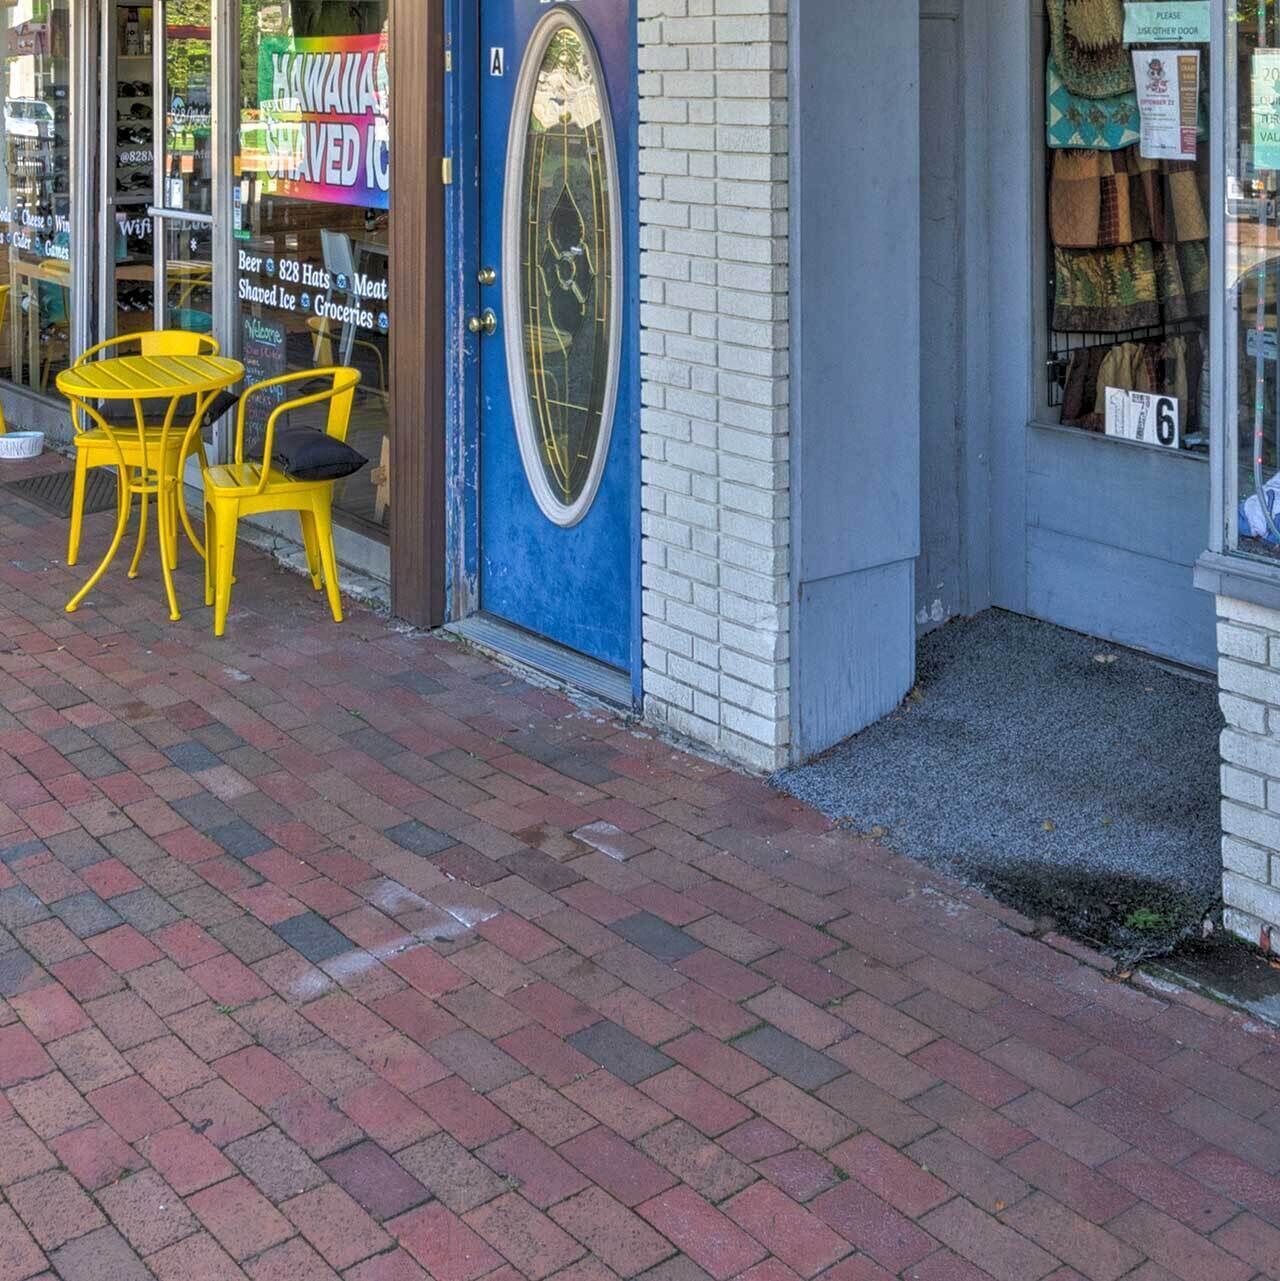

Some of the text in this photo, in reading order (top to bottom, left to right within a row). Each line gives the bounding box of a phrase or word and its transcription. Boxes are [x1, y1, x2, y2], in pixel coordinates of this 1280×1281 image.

[1156, 12, 1181, 20] PLEASE
[1137, 26, 1199, 35] USE OTHER DOOR
[491, 48, 502, 75] A
[1263, 67, 1280, 81] 20
[265, 122, 361, 186] SHAVED
[22, 209, 45, 228] Cheese
[119, 219, 152, 238] Wifi
[13, 231, 31, 250] Cider
[45, 240, 69, 260] Games
[238, 249, 388, 301] Beer 828 Hats Meat
[238, 278, 373, 329] Shaved Ice Groceries
[244, 319, 282, 343] Welcome
